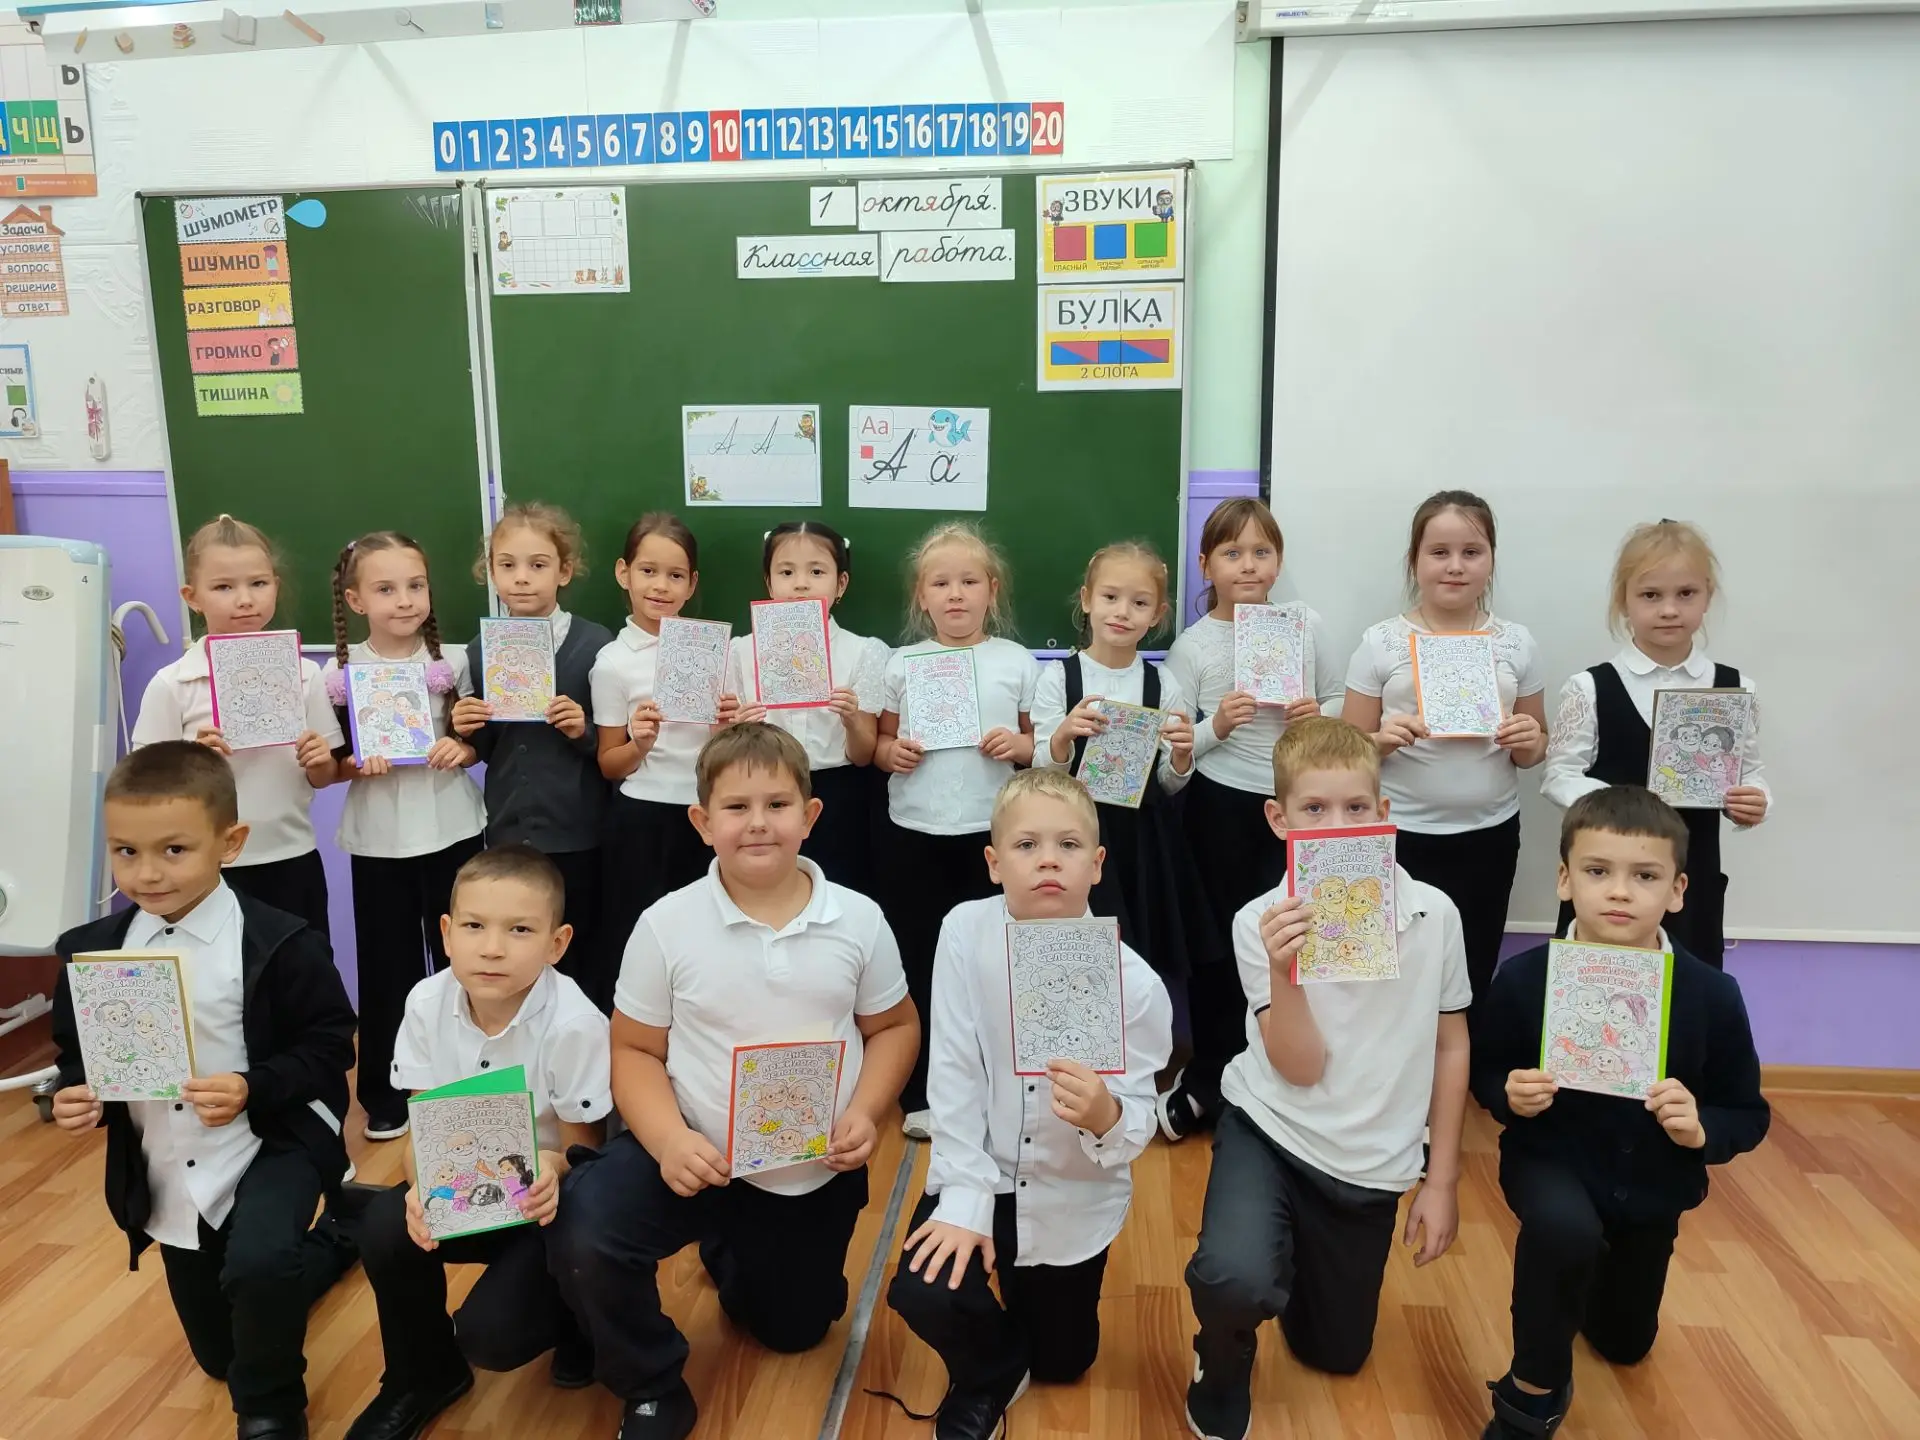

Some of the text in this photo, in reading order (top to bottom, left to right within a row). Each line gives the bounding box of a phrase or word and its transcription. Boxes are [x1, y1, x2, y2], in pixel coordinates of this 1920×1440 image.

[12, 117, 29, 143] Ч
[35, 117, 60, 149] Щ
[441, 112, 1062, 163] 0 1 2 3 4 5 6 7 8 9 10 11 12 13 14 15 16 17 18 19 20
[819, 191, 833, 218] 1
[1065, 187, 1152, 212] ЗВУКИ
[183, 199, 278, 238] ШУМОМЕТР
[2, 224, 45, 237] Задача
[0, 243, 50, 256] условие
[743, 244, 874, 269] Классная
[7, 263, 50, 276] вопрос
[187, 254, 261, 272] ШУМНО
[1053, 263, 1088, 271] ГЛАСНЫЙ
[5, 282, 57, 295] решение
[18, 302, 50, 313] ответ
[187, 299, 261, 314] РАЗГОВОР
[1058, 298, 1162, 325] БУЛКА
[196, 344, 262, 360] ГРОМКО
[1080, 366, 1139, 379] 2 СЛОГА
[199, 387, 270, 401] ТИШИНА
[81, 575, 88, 584] 4
[1043, 930, 1055, 943] С
